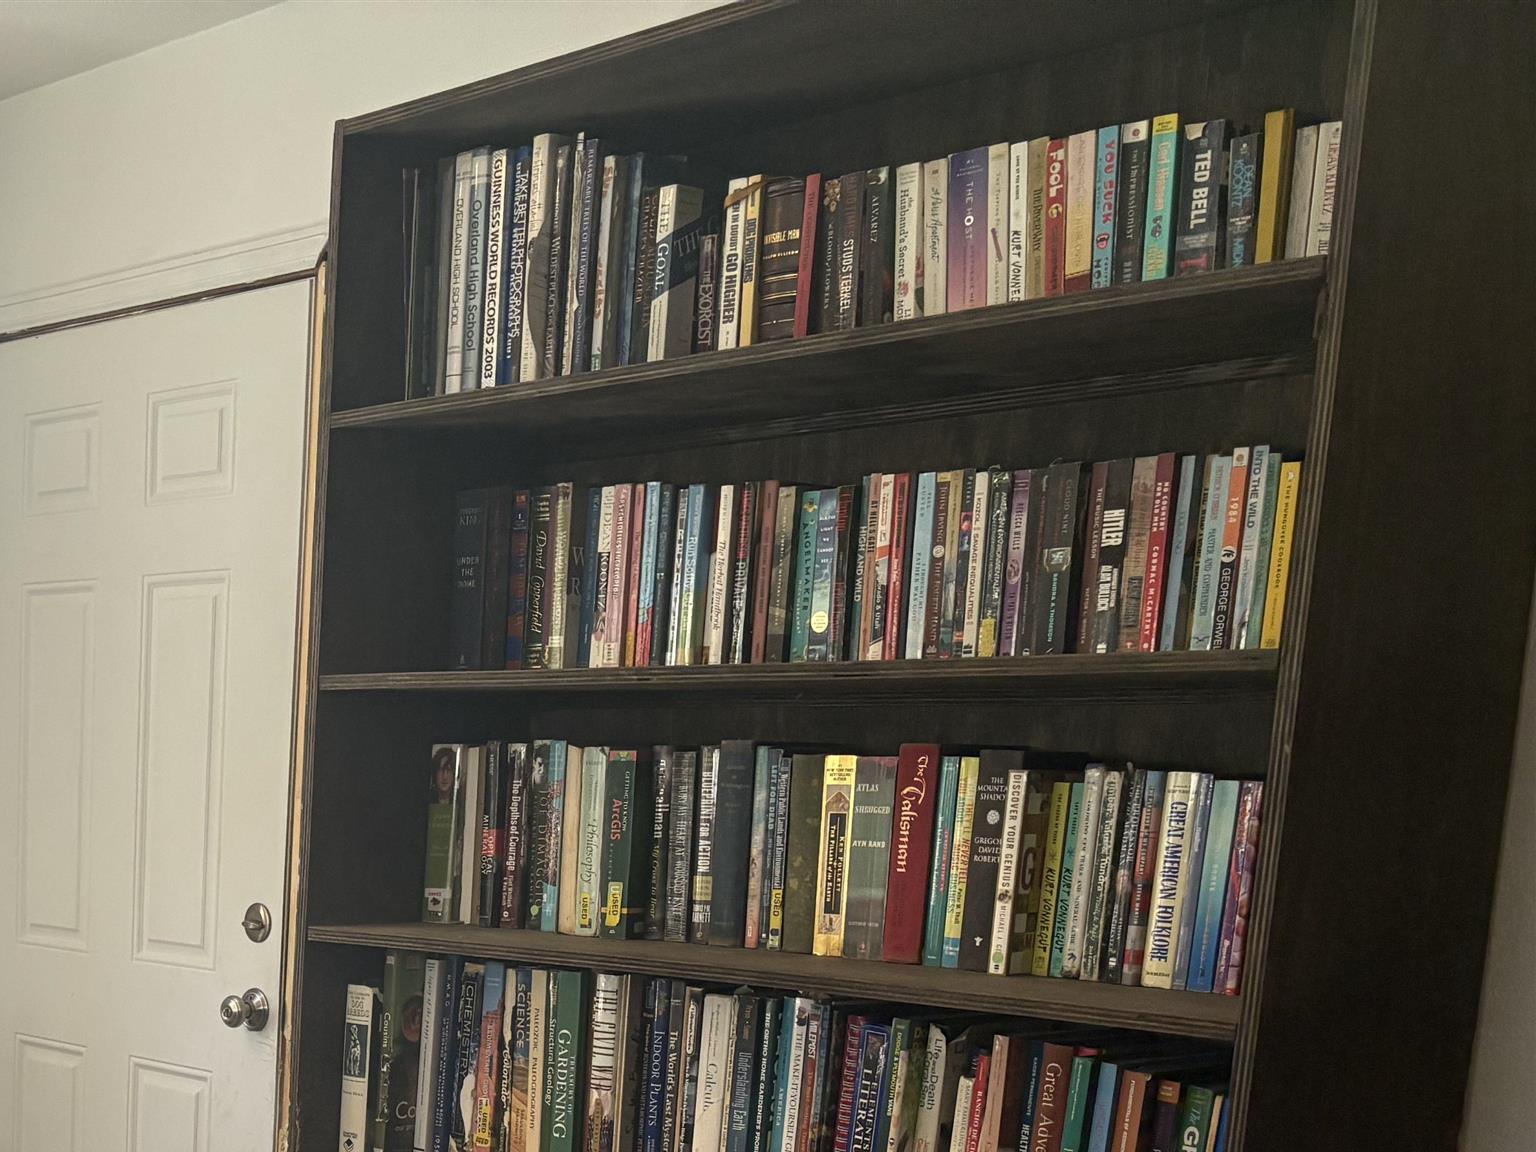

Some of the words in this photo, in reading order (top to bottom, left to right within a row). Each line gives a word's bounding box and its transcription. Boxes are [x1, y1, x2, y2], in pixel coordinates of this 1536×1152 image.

[1049, 149, 1064, 197] FOOL
[1194, 150, 1212, 182] TED
[491, 159, 503, 228] GUINNESS
[519, 173, 529, 200] TAKE
[516, 204, 526, 246] BETTER
[746, 218, 757, 237] DOG
[899, 189, 909, 244] Husband's
[1189, 187, 1208, 229] BELL
[470, 200, 482, 265] Overland
[730, 225, 738, 252] DOUBT
[1011, 230, 1021, 256] KURT
[489, 230, 500, 280] WORLD
[654, 243, 669, 290] GOAL
[726, 254, 738, 272] GO
[744, 239, 755, 283] PROBLEMS
[842, 239, 854, 273] STUDS
[898, 246, 907, 278] Secret
[467, 270, 479, 300] High
[512, 248, 524, 337] PHOTOGRAPHS
[722, 274, 736, 324] HIGHER
[839, 273, 852, 312] TERKEL
[465, 305, 477, 351] School
[485, 283, 497, 344] RECORDS
[697, 284, 713, 346] EXORCIST
[484, 348, 494, 379] 2003
[1253, 450, 1263, 475] INTO
[1155, 481, 1163, 497] FOR
[1163, 481, 1169, 493] NO
[1250, 479, 1260, 499] THE
[974, 498, 982, 526] KOZOL
[1100, 508, 1126, 547] HITLER
[1152, 515, 1160, 532] MEN
[1160, 496, 1168, 531] COUNTRY
[1228, 497, 1239, 523] 1984
[1246, 502, 1257, 529] WILD
[535, 530, 547, 569] David
[602, 511, 612, 551] DEAN
[858, 526, 868, 551] HIGH
[971, 533, 979, 563] SAVAGE
[596, 553, 609, 609] KOONTZ
[801, 522, 811, 611] ANGELMAKER
[856, 554, 865, 575] AND
[1149, 546, 1160, 584] CORMAC
[530, 575, 545, 634] Copperfield
[854, 577, 863, 602] WILD
[967, 565, 977, 620] INEQUALITIES
[1217, 568, 1231, 611] GEORGE
[1143, 588, 1156, 635] McCARTHY
[1212, 614, 1226, 650] ORWEL
[916, 755, 929, 776] The
[512, 780, 522, 795] The
[700, 771, 714, 819] BLUEPRINT
[1009, 774, 1022, 821] DISCOVER
[509, 796, 520, 824] Depths
[610, 799, 623, 841] ArcGIS
[653, 797, 669, 839] allman
[699, 822, 710, 837] FOR
[896, 777, 926, 873] Talisman
[1170, 802, 1189, 840] GREAT
[481, 815, 489, 875] MINERALOGY
[511, 825, 519, 835] of
[1006, 825, 1016, 849] YOUR
[486, 836, 494, 874] OPTICAL
[506, 836, 518, 870] Courage
[580, 823, 599, 885] Philosophy
[697, 839, 712, 873] ACTION
[1001, 853, 1014, 888] GENIUS
[1159, 843, 1182, 900] AMERICAN
[1045, 867, 1056, 895] KURT
[1062, 867, 1073, 895] KURT
[581, 897, 589, 920] USED
[611, 893, 619, 917] USED
[772, 893, 780, 917] USED
[1038, 898, 1053, 952] VONNEGUT
[1055, 899, 1070, 953] VONNEGUT
[1150, 905, 1177, 962] FOLKLORE
[515, 983, 526, 1049] SCIENCE
[596, 989, 619, 1014] THE
[382, 1012, 391, 1048] Cousins
[459, 984, 474, 1078] CHEMISTRY
[532, 1008, 540, 1051] PALEOZOIC
[547, 1018, 556, 1064] Structural
[592, 1022, 616, 1057] CIVIL
[669, 1031, 678, 1050] The
[795, 1032, 803, 1053] THE
[807, 1019, 818, 1060] MILEPOST
[651, 1030, 665, 1078] INDOOR
[666, 1052, 677, 1091] World's
[500, 1049, 510, 1103] Colorado
[529, 1057, 538, 1129] PALEOGEOGRAPHY
[544, 1066, 554, 1106] Geology
[552, 1029, 572, 1139] GARDENING
[590, 1066, 613, 1092] WAR
[732, 1051, 752, 1109] Understanding
[1041, 1062, 1063, 1107] Great
[648, 1083, 660, 1127] PLANTS
[665, 1093, 676, 1115] Last
[786, 1055, 801, 1141] MAKE-IT-YOURSELF
[863, 1082, 878, 1152] ELEMENTS
[732, 1110, 746, 1131] Earth
